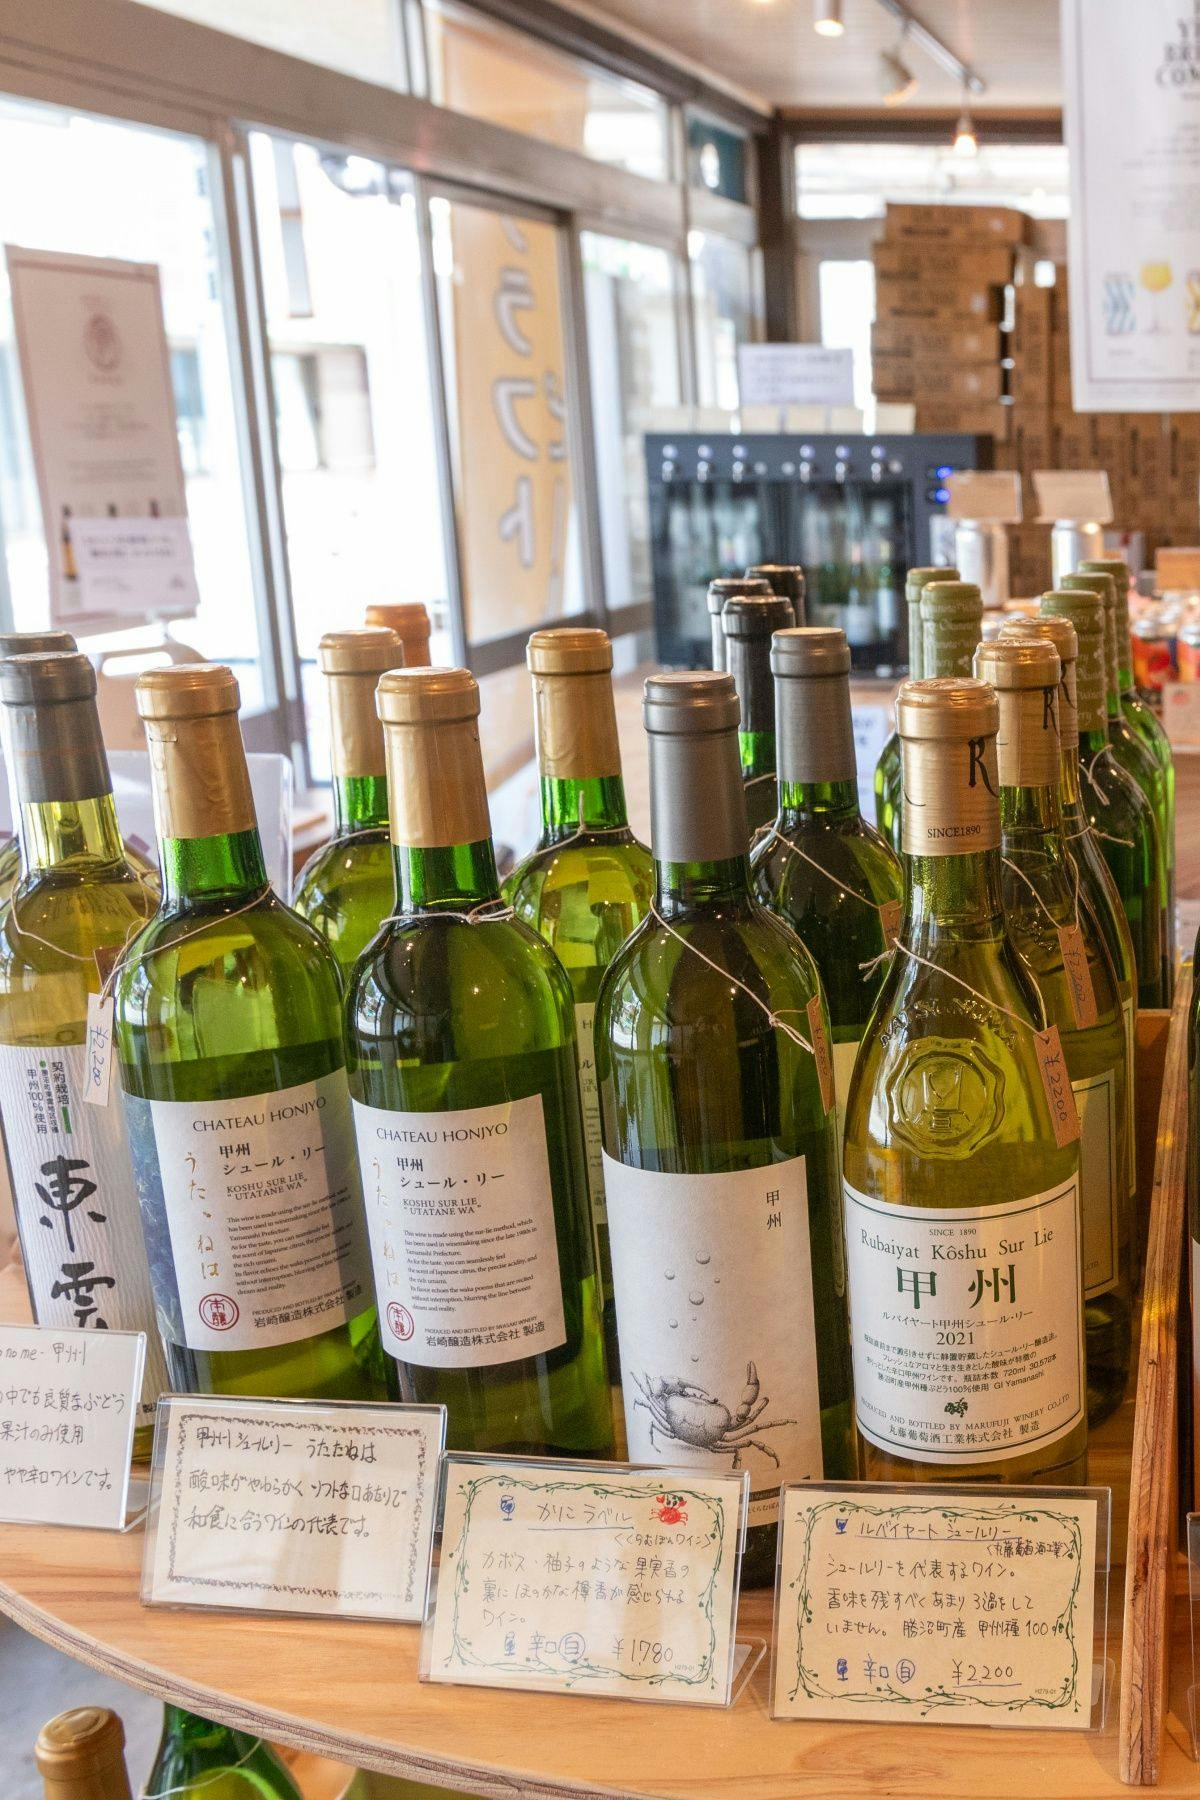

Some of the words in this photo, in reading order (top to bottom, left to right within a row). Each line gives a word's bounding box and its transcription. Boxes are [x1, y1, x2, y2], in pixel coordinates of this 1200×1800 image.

[927, 825, 981, 839] SINCE1890
[193, 1114, 265, 1132] CHATEAU
[270, 1096, 327, 1123] HONJYO
[376, 1128, 437, 1143] CHATEAU
[443, 1122, 508, 1142] HONJYO
[219, 1143, 251, 1158] 甲州
[223, 1145, 326, 1176] シュール・リー
[397, 1157, 424, 1172] 甲州
[227, 1182, 263, 1194] KOSHU
[266, 1177, 287, 1188] SUR
[289, 1172, 304, 1182] LIE
[400, 1173, 505, 1189] シュール・リー
[403, 1199, 435, 1207] KOSHU
[438, 1199, 458, 1207] SUR
[461, 1197, 477, 1206] LIE
[766, 1190, 782, 1231] 甲州
[959, 1228, 977, 1236] 1890
[861, 1229, 920, 1260] Rubaiyat
[932, 1244, 987, 1261] Kôshu
[999, 1238, 1025, 1255] Sur
[1034, 1228, 1054, 1247] Lie
[936, 1331, 975, 1346] 2021
[52, 1341, 87, 1366] 甲州
